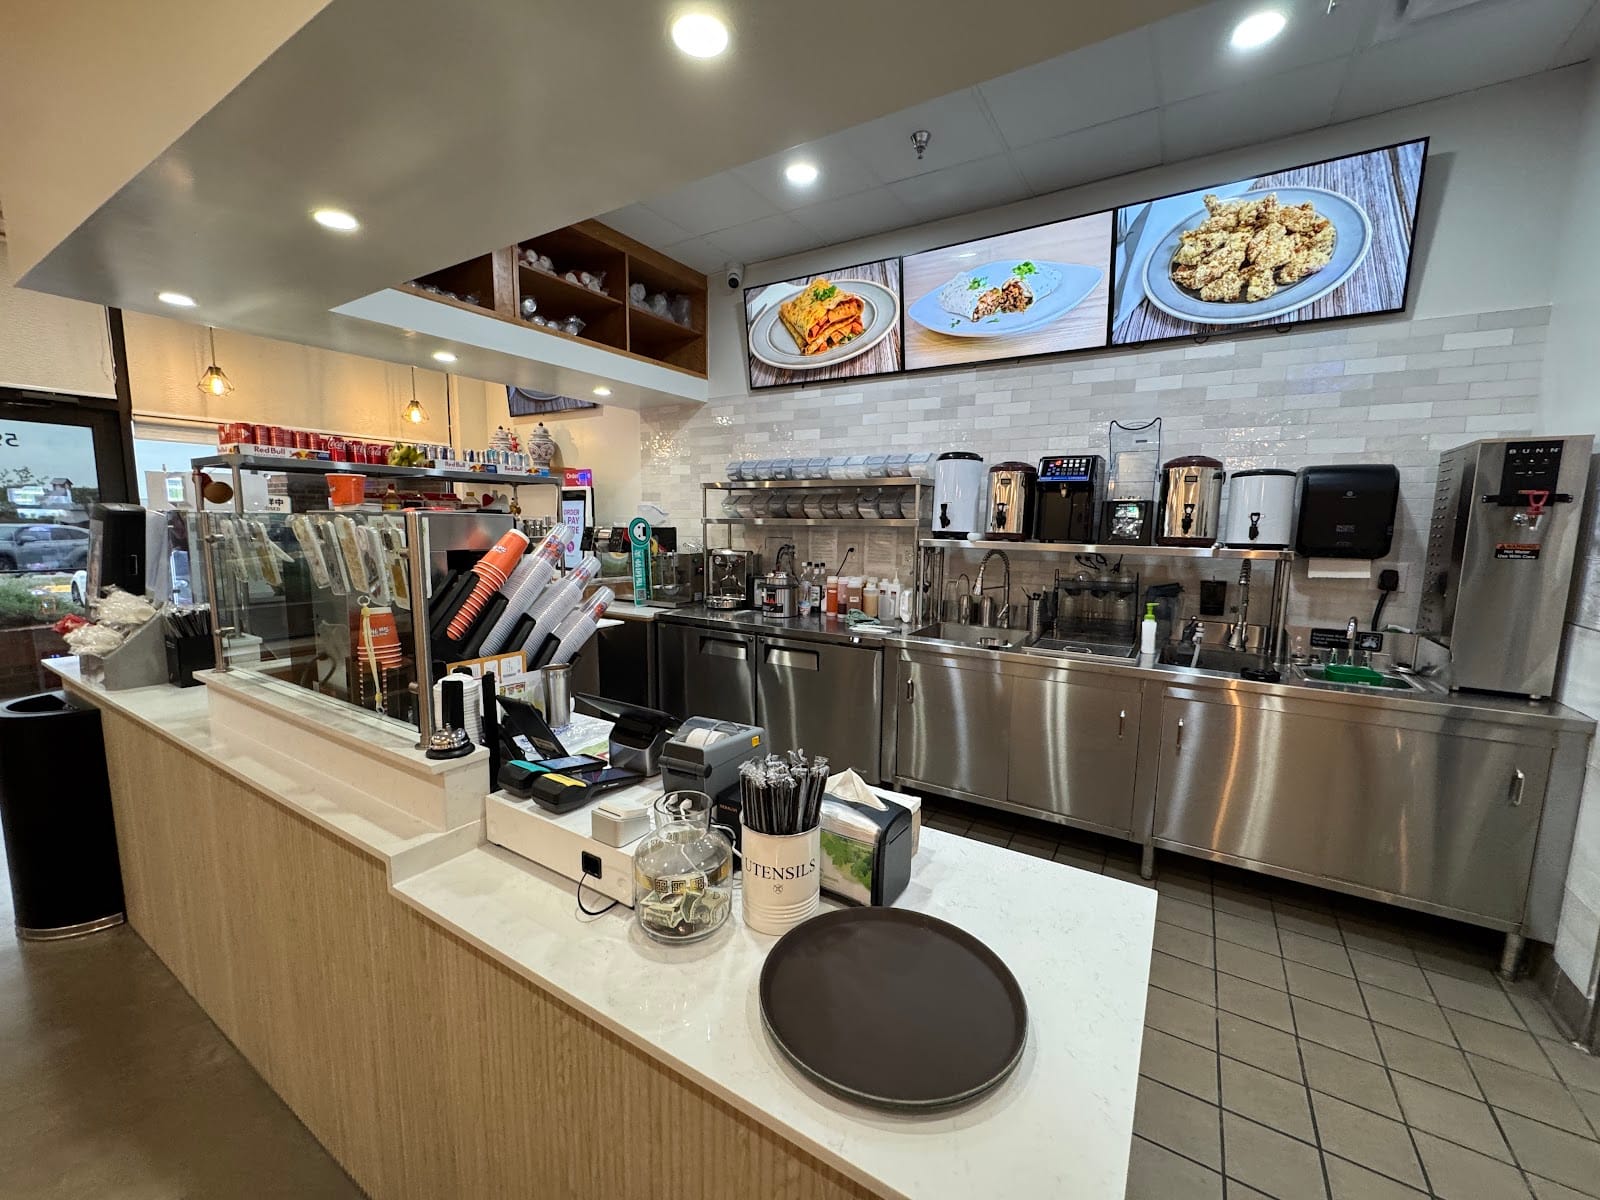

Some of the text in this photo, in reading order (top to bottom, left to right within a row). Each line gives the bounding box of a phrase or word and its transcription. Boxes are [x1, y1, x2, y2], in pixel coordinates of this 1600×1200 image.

[254, 445, 286, 455] Red Bull
[1508, 447, 1558, 455] BUNN
[564, 508, 580, 516] ORDER
[567, 516, 580, 525] PAY
[745, 857, 816, 880] UTENSILS
